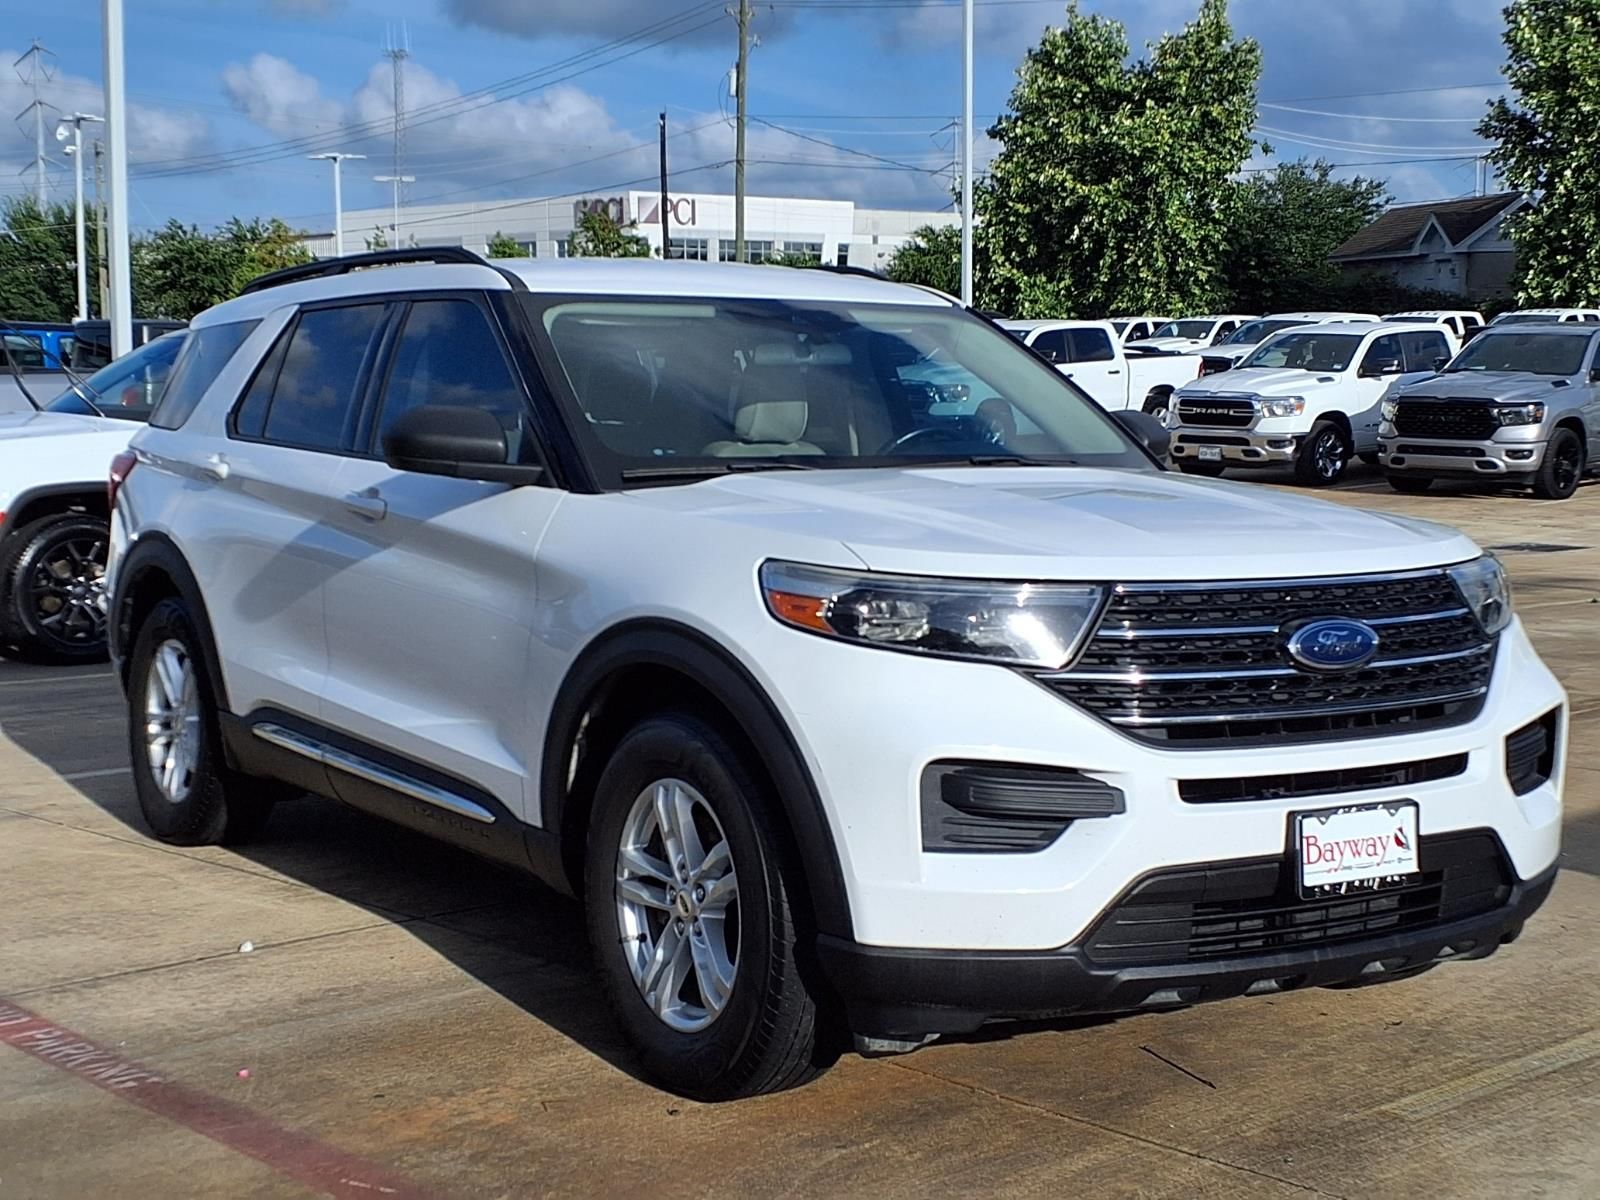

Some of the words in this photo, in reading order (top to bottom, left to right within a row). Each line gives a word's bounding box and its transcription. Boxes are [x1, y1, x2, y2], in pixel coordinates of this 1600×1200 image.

[1196, 407, 1228, 415] RAM
[1317, 630, 1362, 656] Ford
[1302, 834, 1391, 873] Bayway
[7, 1026, 166, 1089] PARKING
